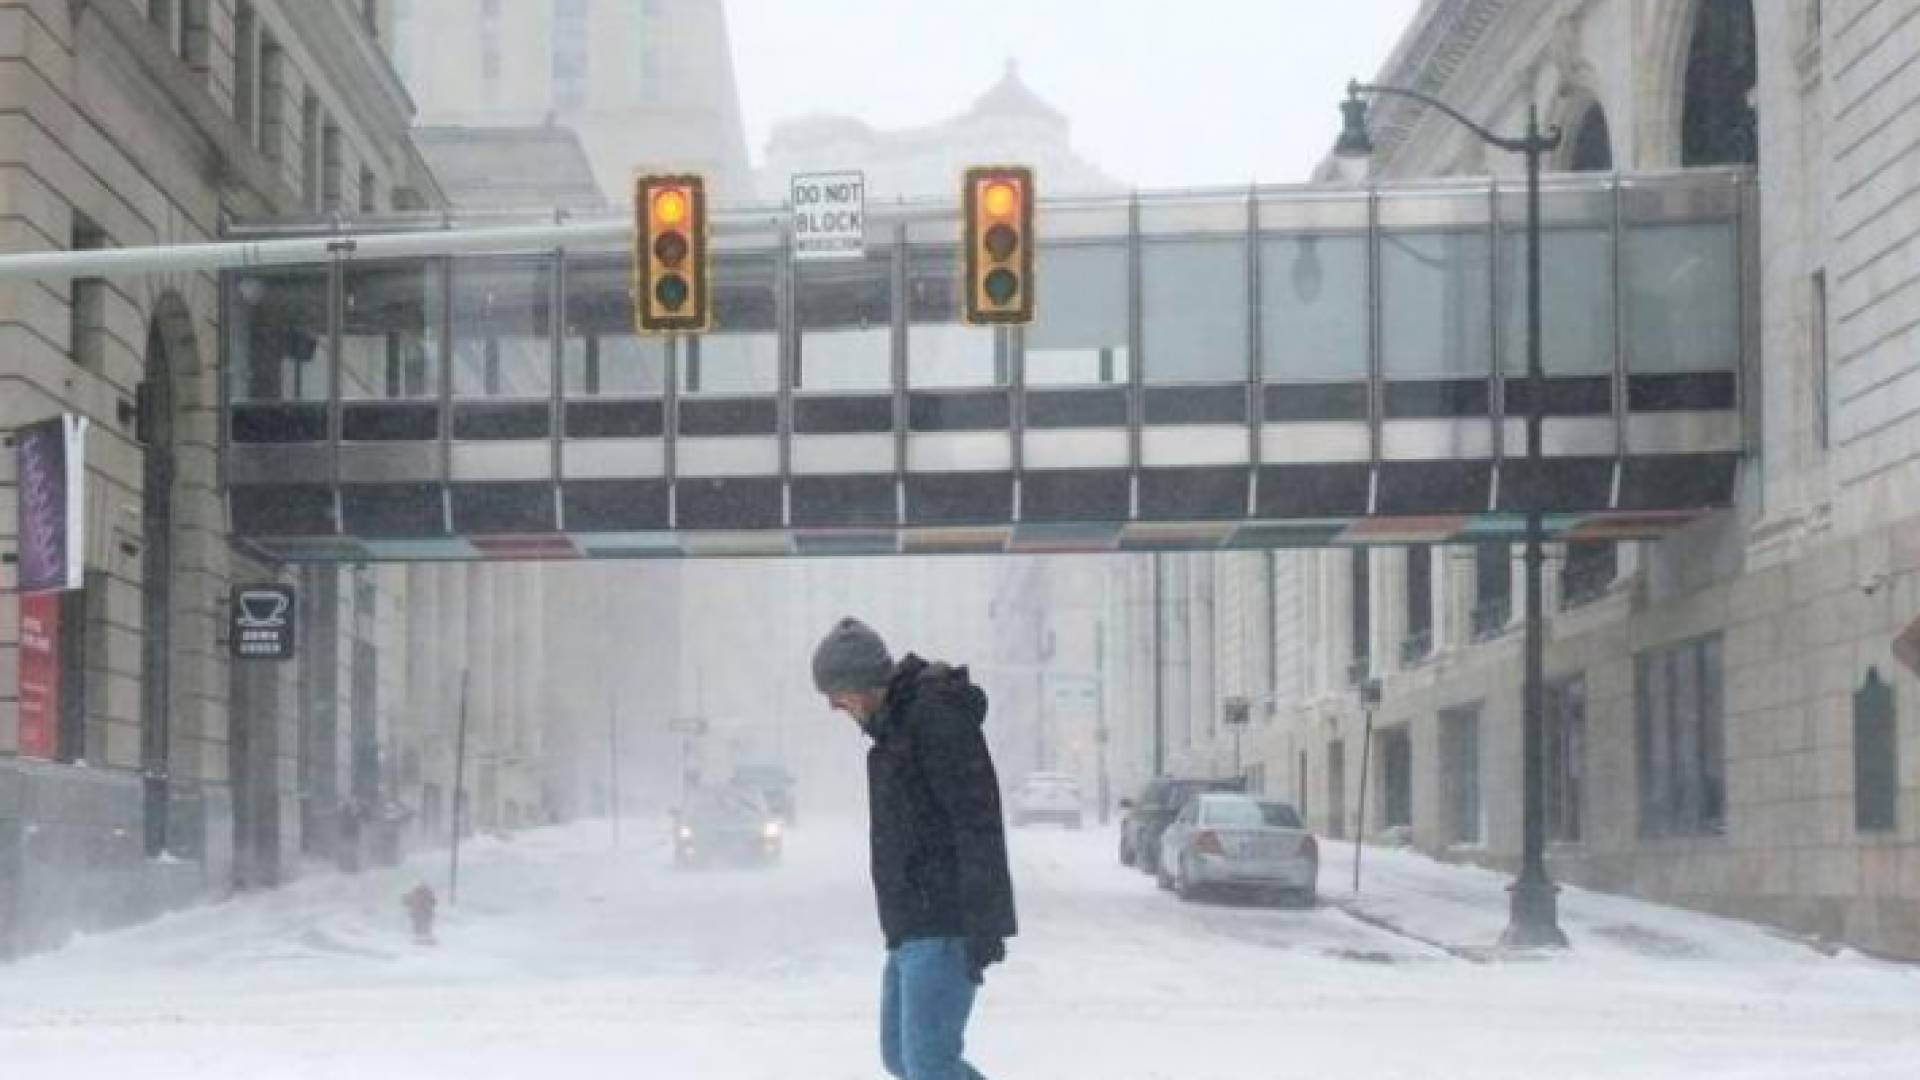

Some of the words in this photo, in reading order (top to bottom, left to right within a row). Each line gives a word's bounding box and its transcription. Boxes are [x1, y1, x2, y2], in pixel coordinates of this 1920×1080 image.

[796, 185, 819, 204] DO
[825, 184, 861, 203] NOT
[796, 211, 861, 233] BLOCK
